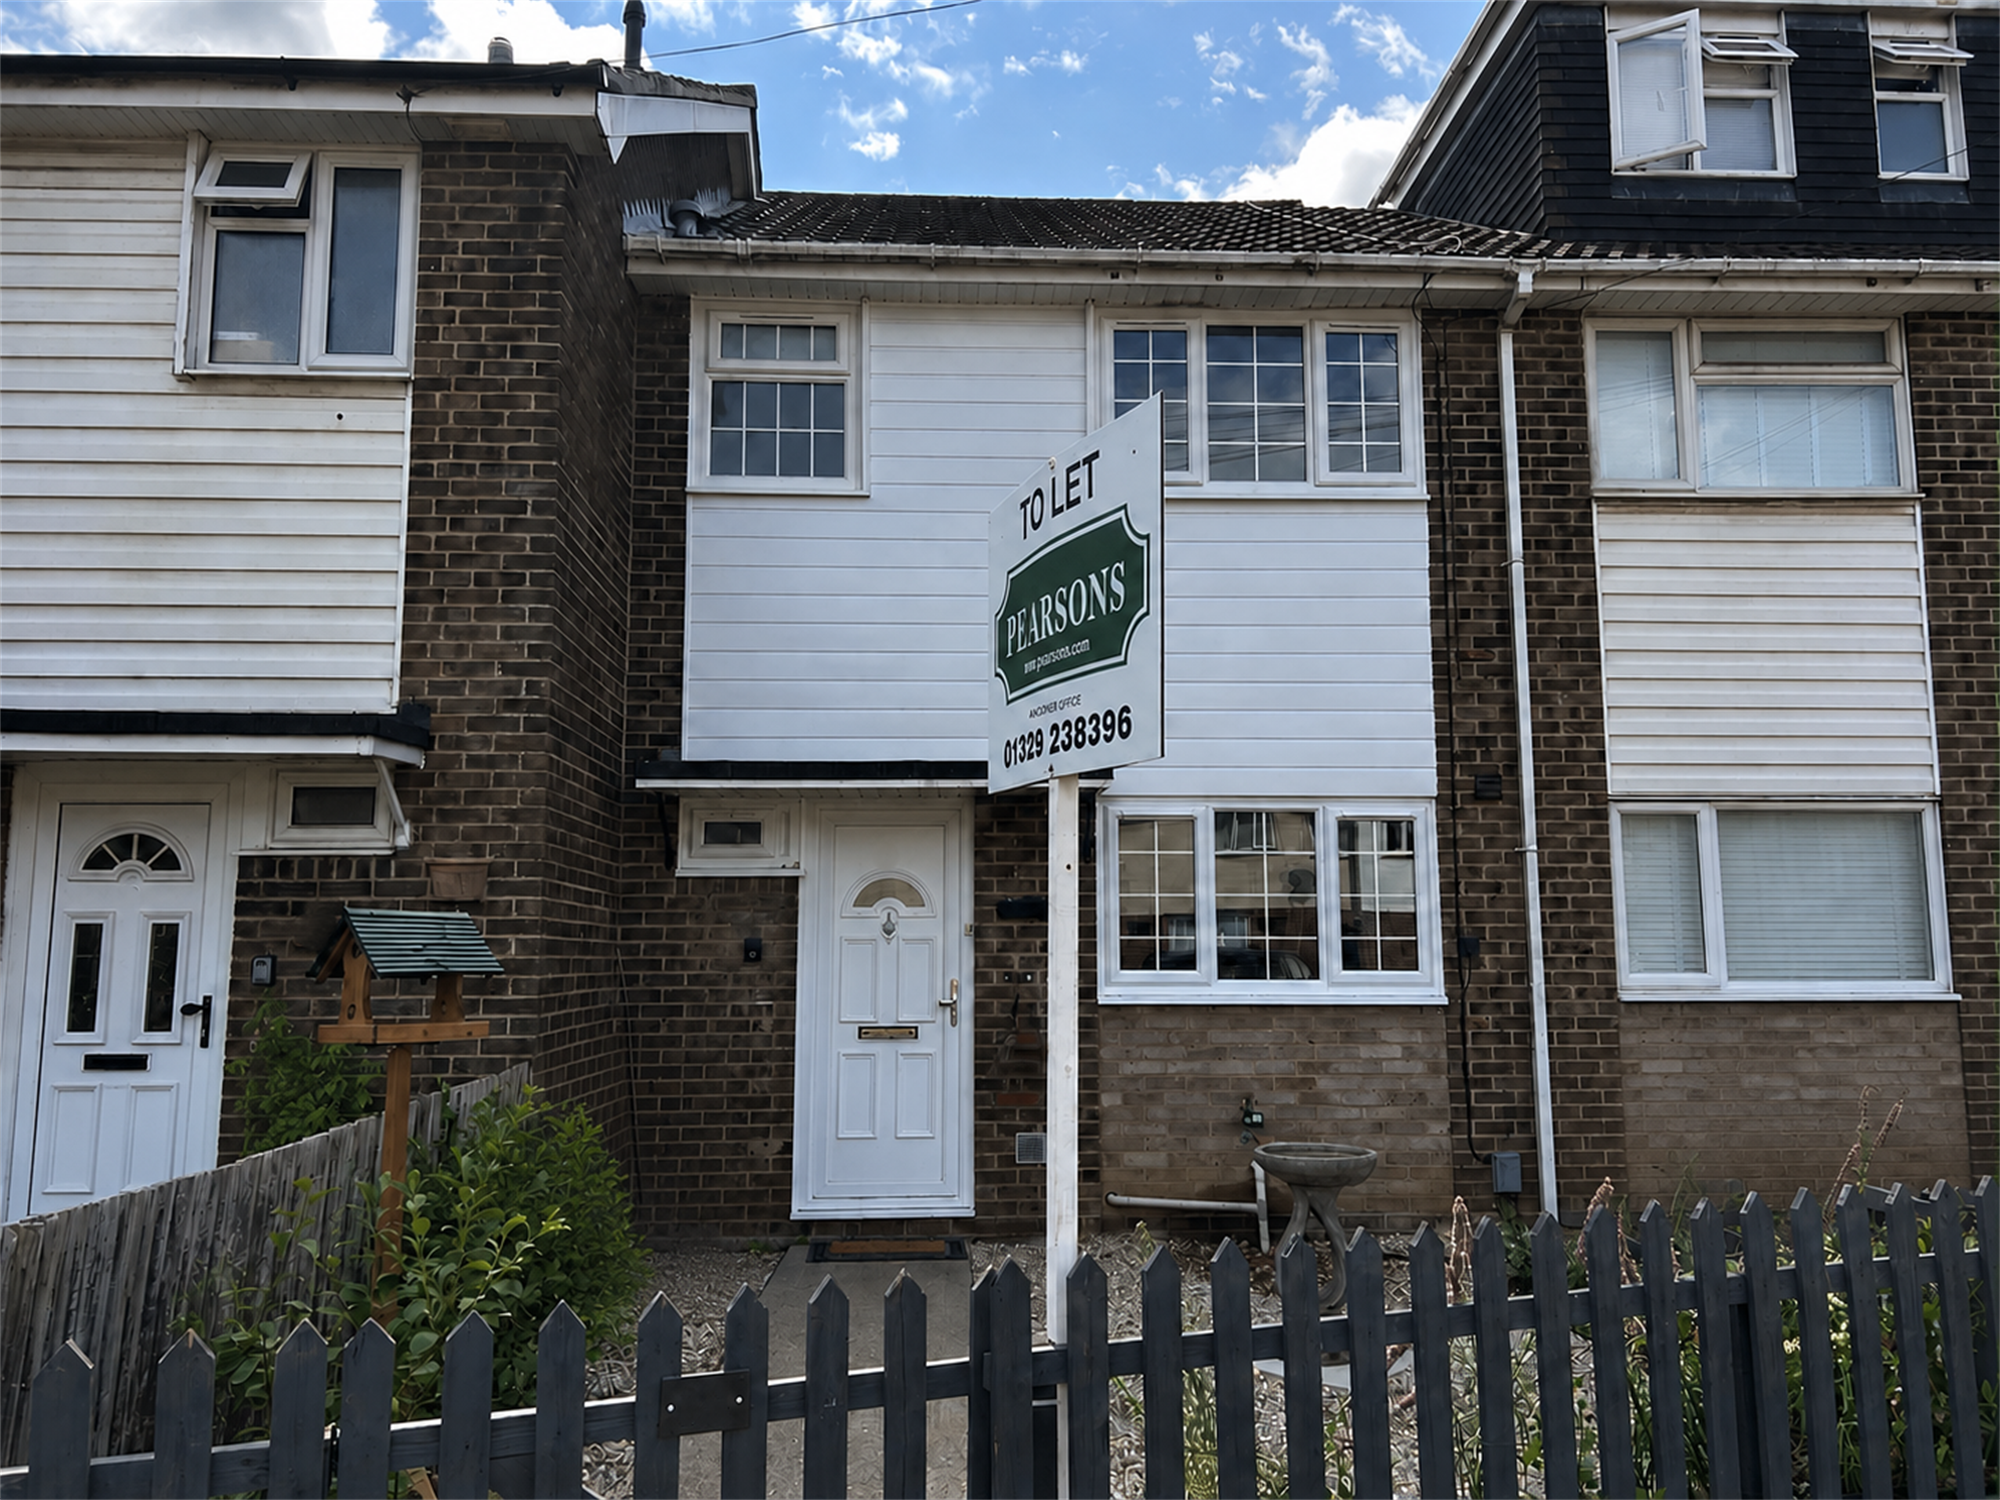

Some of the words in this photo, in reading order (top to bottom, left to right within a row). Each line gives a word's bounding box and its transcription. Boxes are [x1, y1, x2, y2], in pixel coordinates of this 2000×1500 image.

[1020, 487, 1044, 540] TO
[1051, 449, 1100, 518] LET
[1006, 561, 1125, 658] PEARSONS
[1004, 727, 1043, 769] 01329
[1049, 705, 1132, 755] 238396
